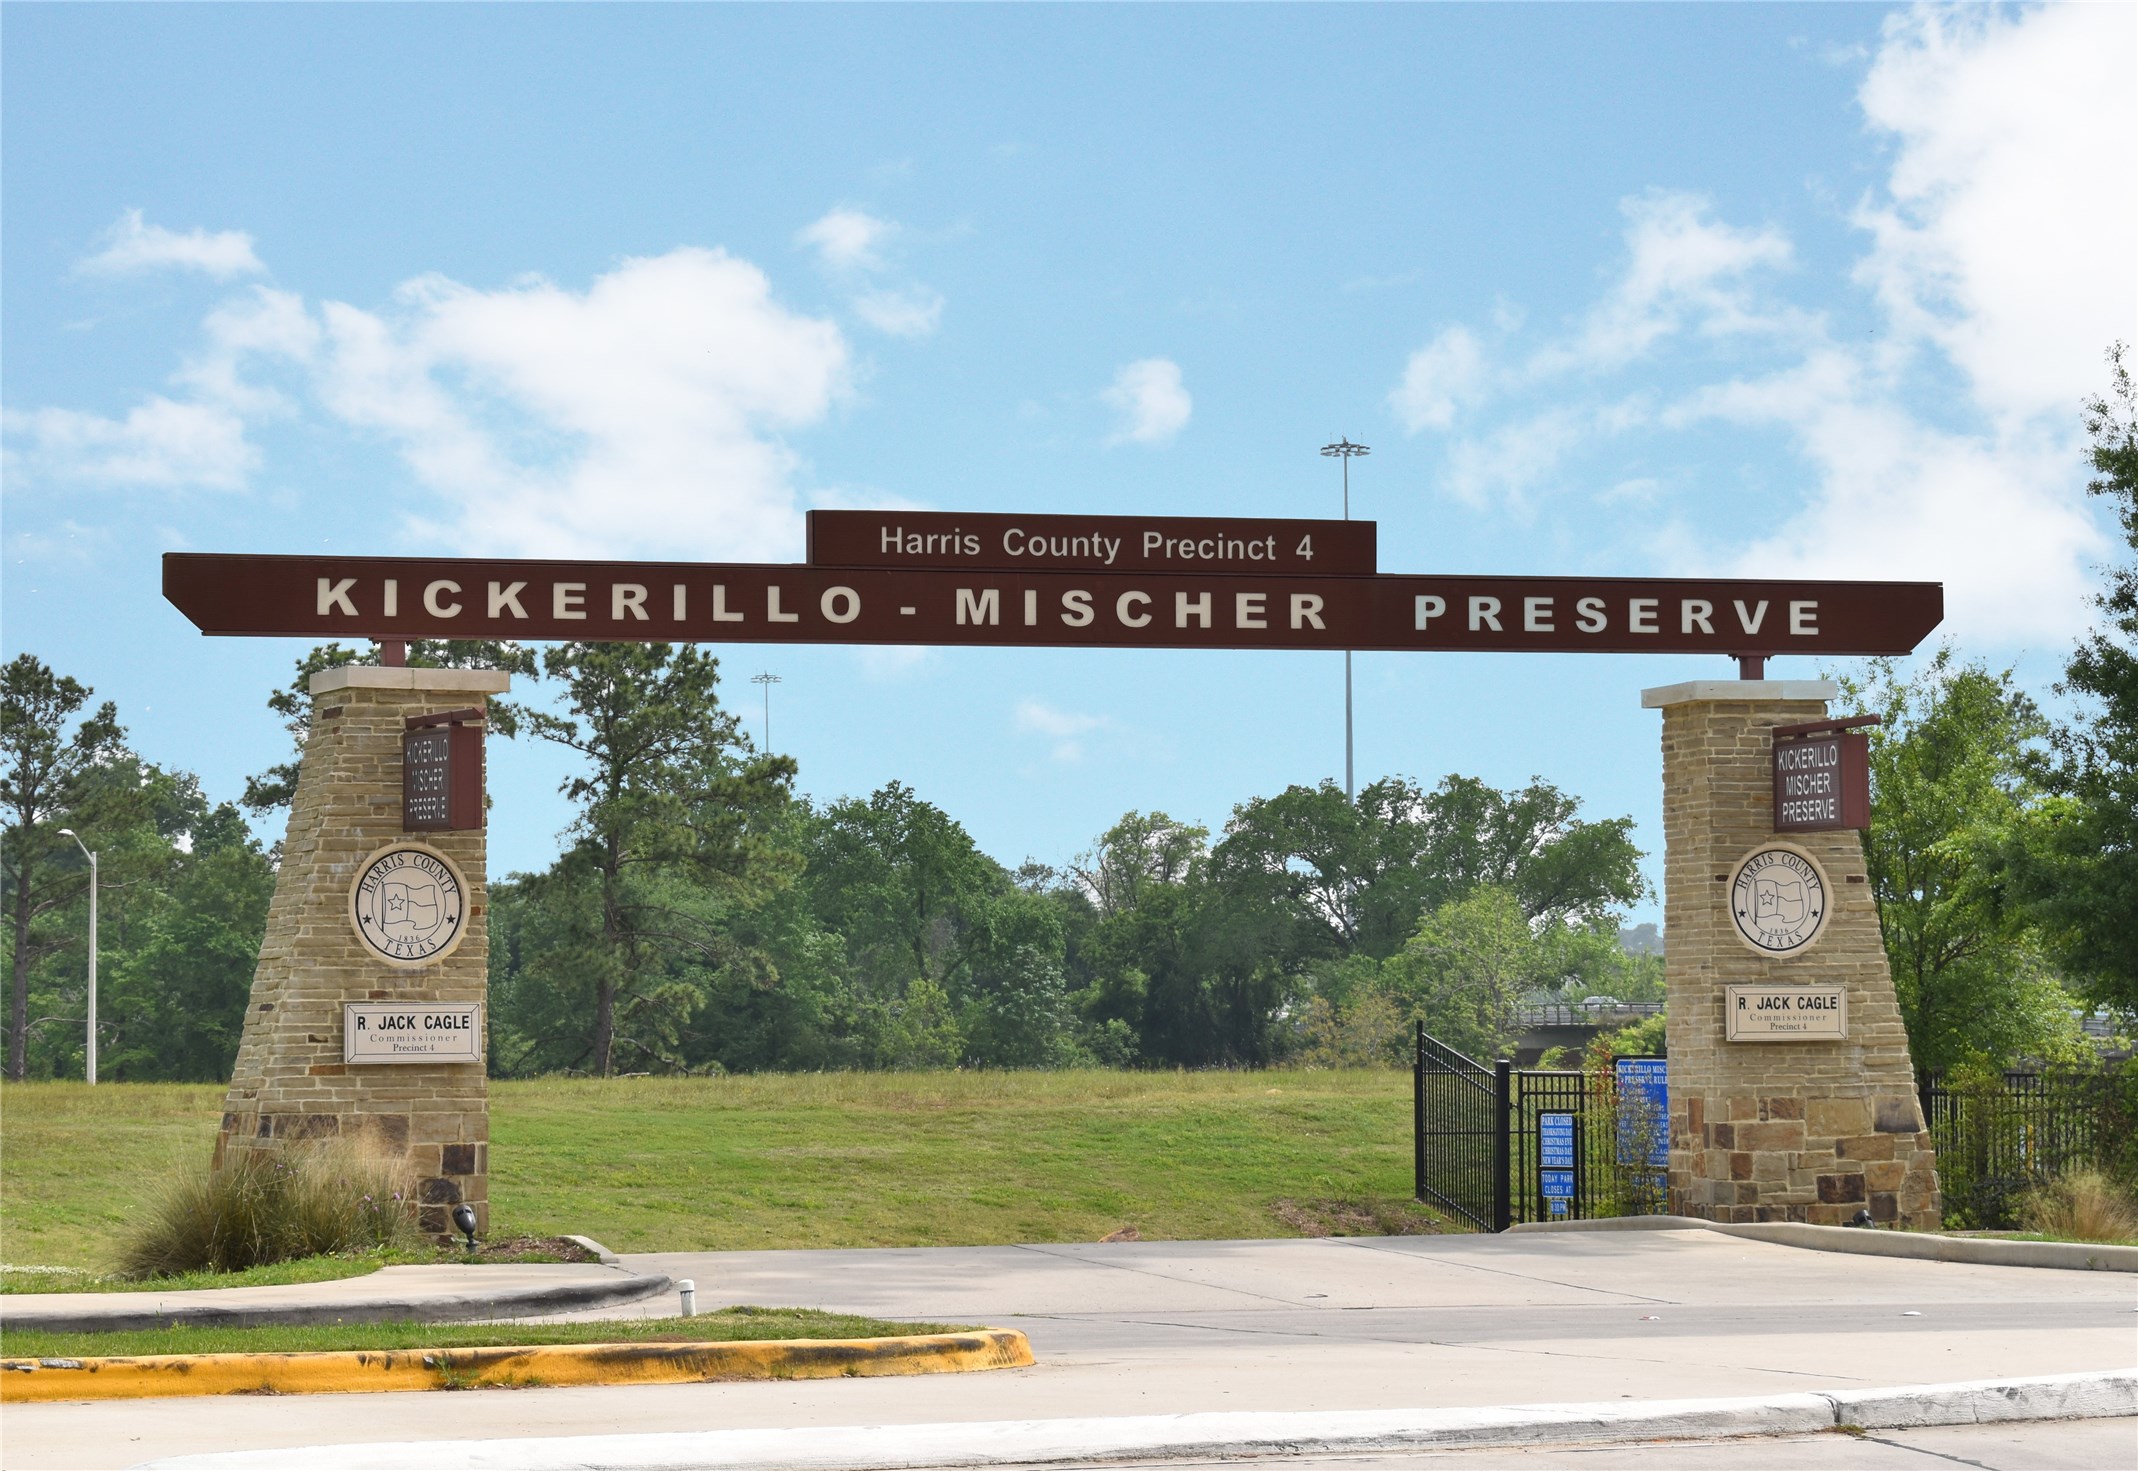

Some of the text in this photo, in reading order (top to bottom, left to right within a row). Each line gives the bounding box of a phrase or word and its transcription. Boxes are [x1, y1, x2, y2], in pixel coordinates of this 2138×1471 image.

[881, 527, 1314, 565] Harris County Precinct 4
[316, 578, 861, 624] KICKERILLO
[956, 588, 1327, 630] MISCHER
[1415, 595, 1819, 636] PRESERVE
[406, 739, 448, 765] KICKERILLO
[1778, 745, 1837, 771] KICKERILLO
[1786, 773, 1831, 796] MISCHER
[409, 796, 446, 820] PRESERVE
[1782, 799, 1835, 823] PRESERVE
[361, 854, 457, 894] HARRIS COUNTY
[1736, 853, 1820, 891] HARRIS COUNTY
[398, 934, 421, 942] 1836
[1757, 931, 1803, 948] TEXAS
[383, 938, 437, 957] TEXAS
[1738, 996, 1837, 1010] R. JACK CAGLE
[357, 1015, 470, 1031] R. JACK CAGLE
[1749, 1013, 1827, 1022] Commissioner
[1770, 1022, 1800, 1031] Precinct
[370, 1033, 458, 1043] Commissioner
[393, 1043, 435, 1052] Precinct 4
[1542, 1116, 1572, 1126] PARK CLOSED
[1542, 1174, 1558, 1183] TODAY
[1544, 1185, 1572, 1194] CLOSES AT
